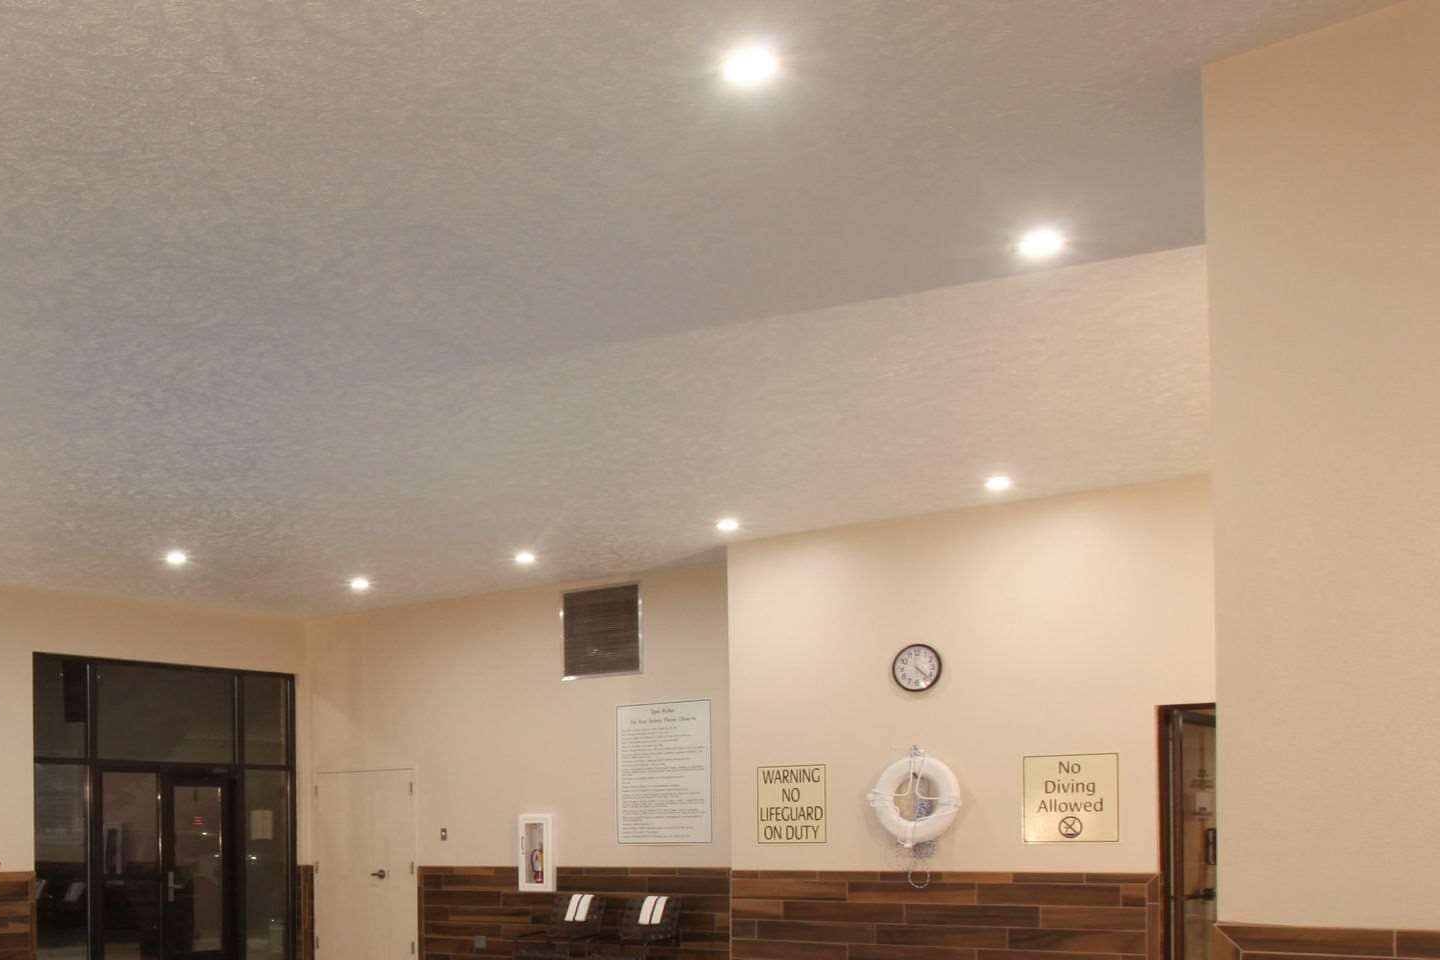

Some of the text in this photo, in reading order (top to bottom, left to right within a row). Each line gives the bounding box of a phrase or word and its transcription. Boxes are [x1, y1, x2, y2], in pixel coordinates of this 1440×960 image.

[762, 767, 821, 784] WARNING
[1058, 761, 1081, 774] No
[782, 787, 801, 802] NO
[1044, 779, 1096, 796] Diving
[1037, 798, 1104, 812] Allowed
[760, 806, 824, 822] LIFEGUARD
[764, 824, 819, 840] ON DUTY
